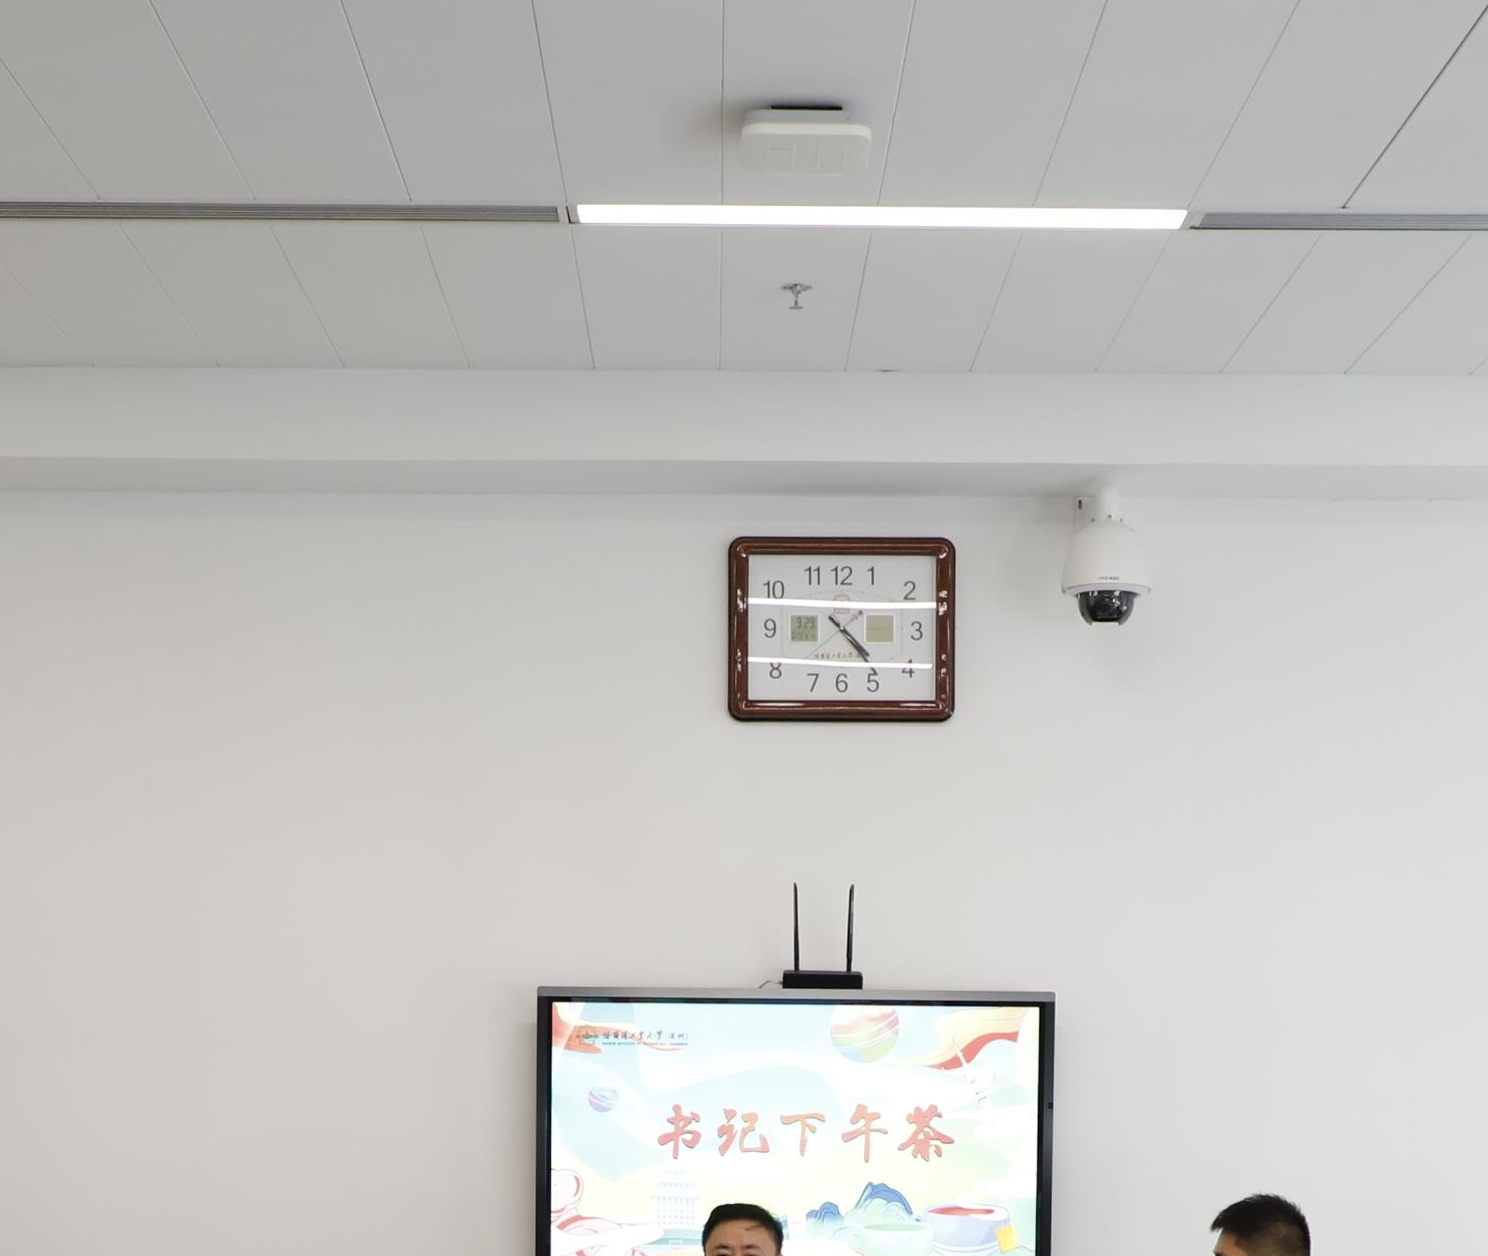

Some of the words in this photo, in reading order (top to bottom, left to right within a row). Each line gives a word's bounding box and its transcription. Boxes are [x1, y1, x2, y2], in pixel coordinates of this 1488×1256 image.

[804, 566, 821, 586] 11
[830, 566, 853, 586] 12
[866, 566, 875, 585] 1
[762, 580, 785, 600] 10
[903, 581, 916, 600] 2
[764, 618, 777, 638] 9
[910, 621, 923, 641] 3
[769, 661, 783, 679] 8
[901, 659, 915, 679] 4
[807, 673, 820, 692] 7
[835, 673, 848, 693] 6
[866, 673, 880, 693] 5
[657, 1103, 955, 1163] 书记下午茶
